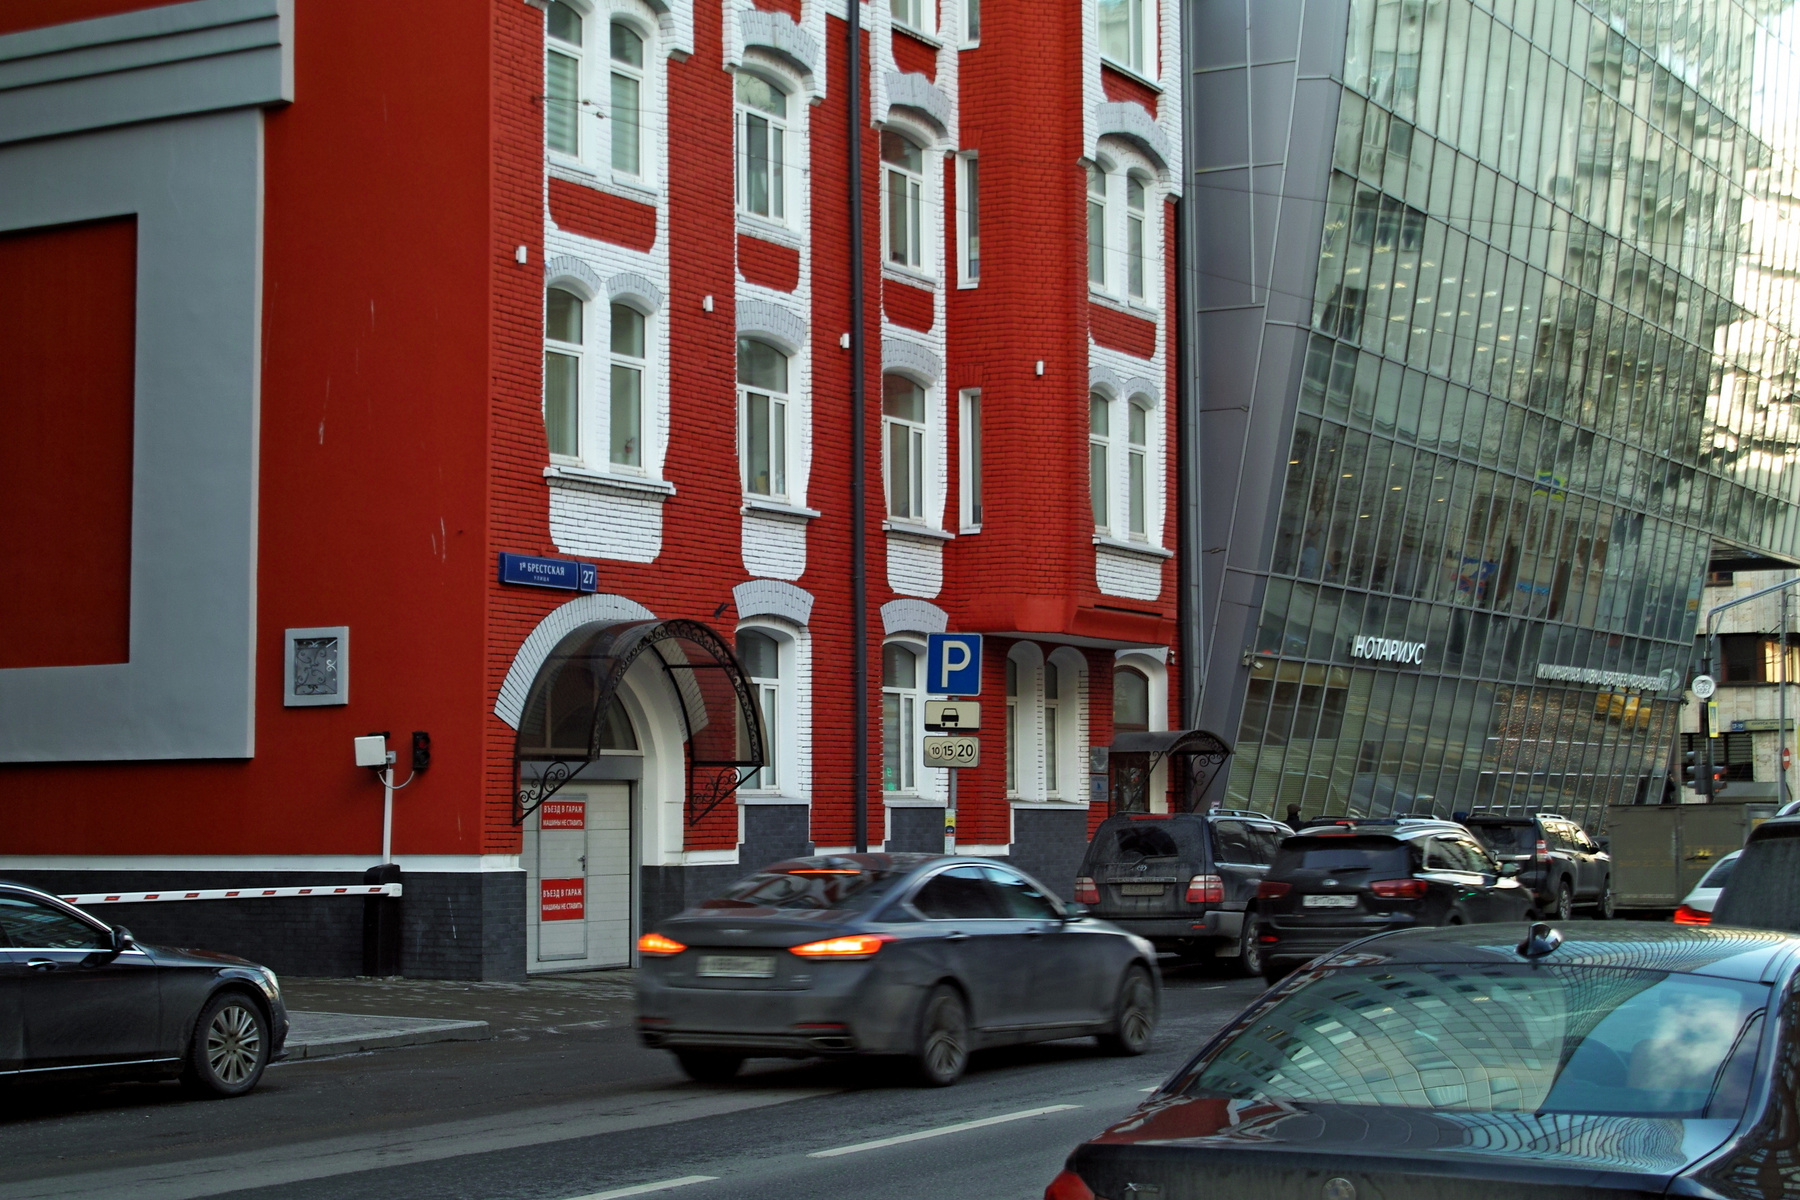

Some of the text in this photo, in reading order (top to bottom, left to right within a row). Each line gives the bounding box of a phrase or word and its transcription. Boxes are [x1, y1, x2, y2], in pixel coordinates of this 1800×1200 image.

[527, 562, 565, 576] БРЕСТСКАЯ
[583, 570, 594, 584] 27
[1354, 635, 1426, 665] НОТАРИУС
[941, 640, 971, 688] P
[932, 744, 974, 757] 10 15 20
[544, 805, 583, 814] ВЪЕЗД В ГАРАЖ
[543, 889, 560, 898] ВЪЕЗД
[565, 888, 582, 896] ГАРАЖ
